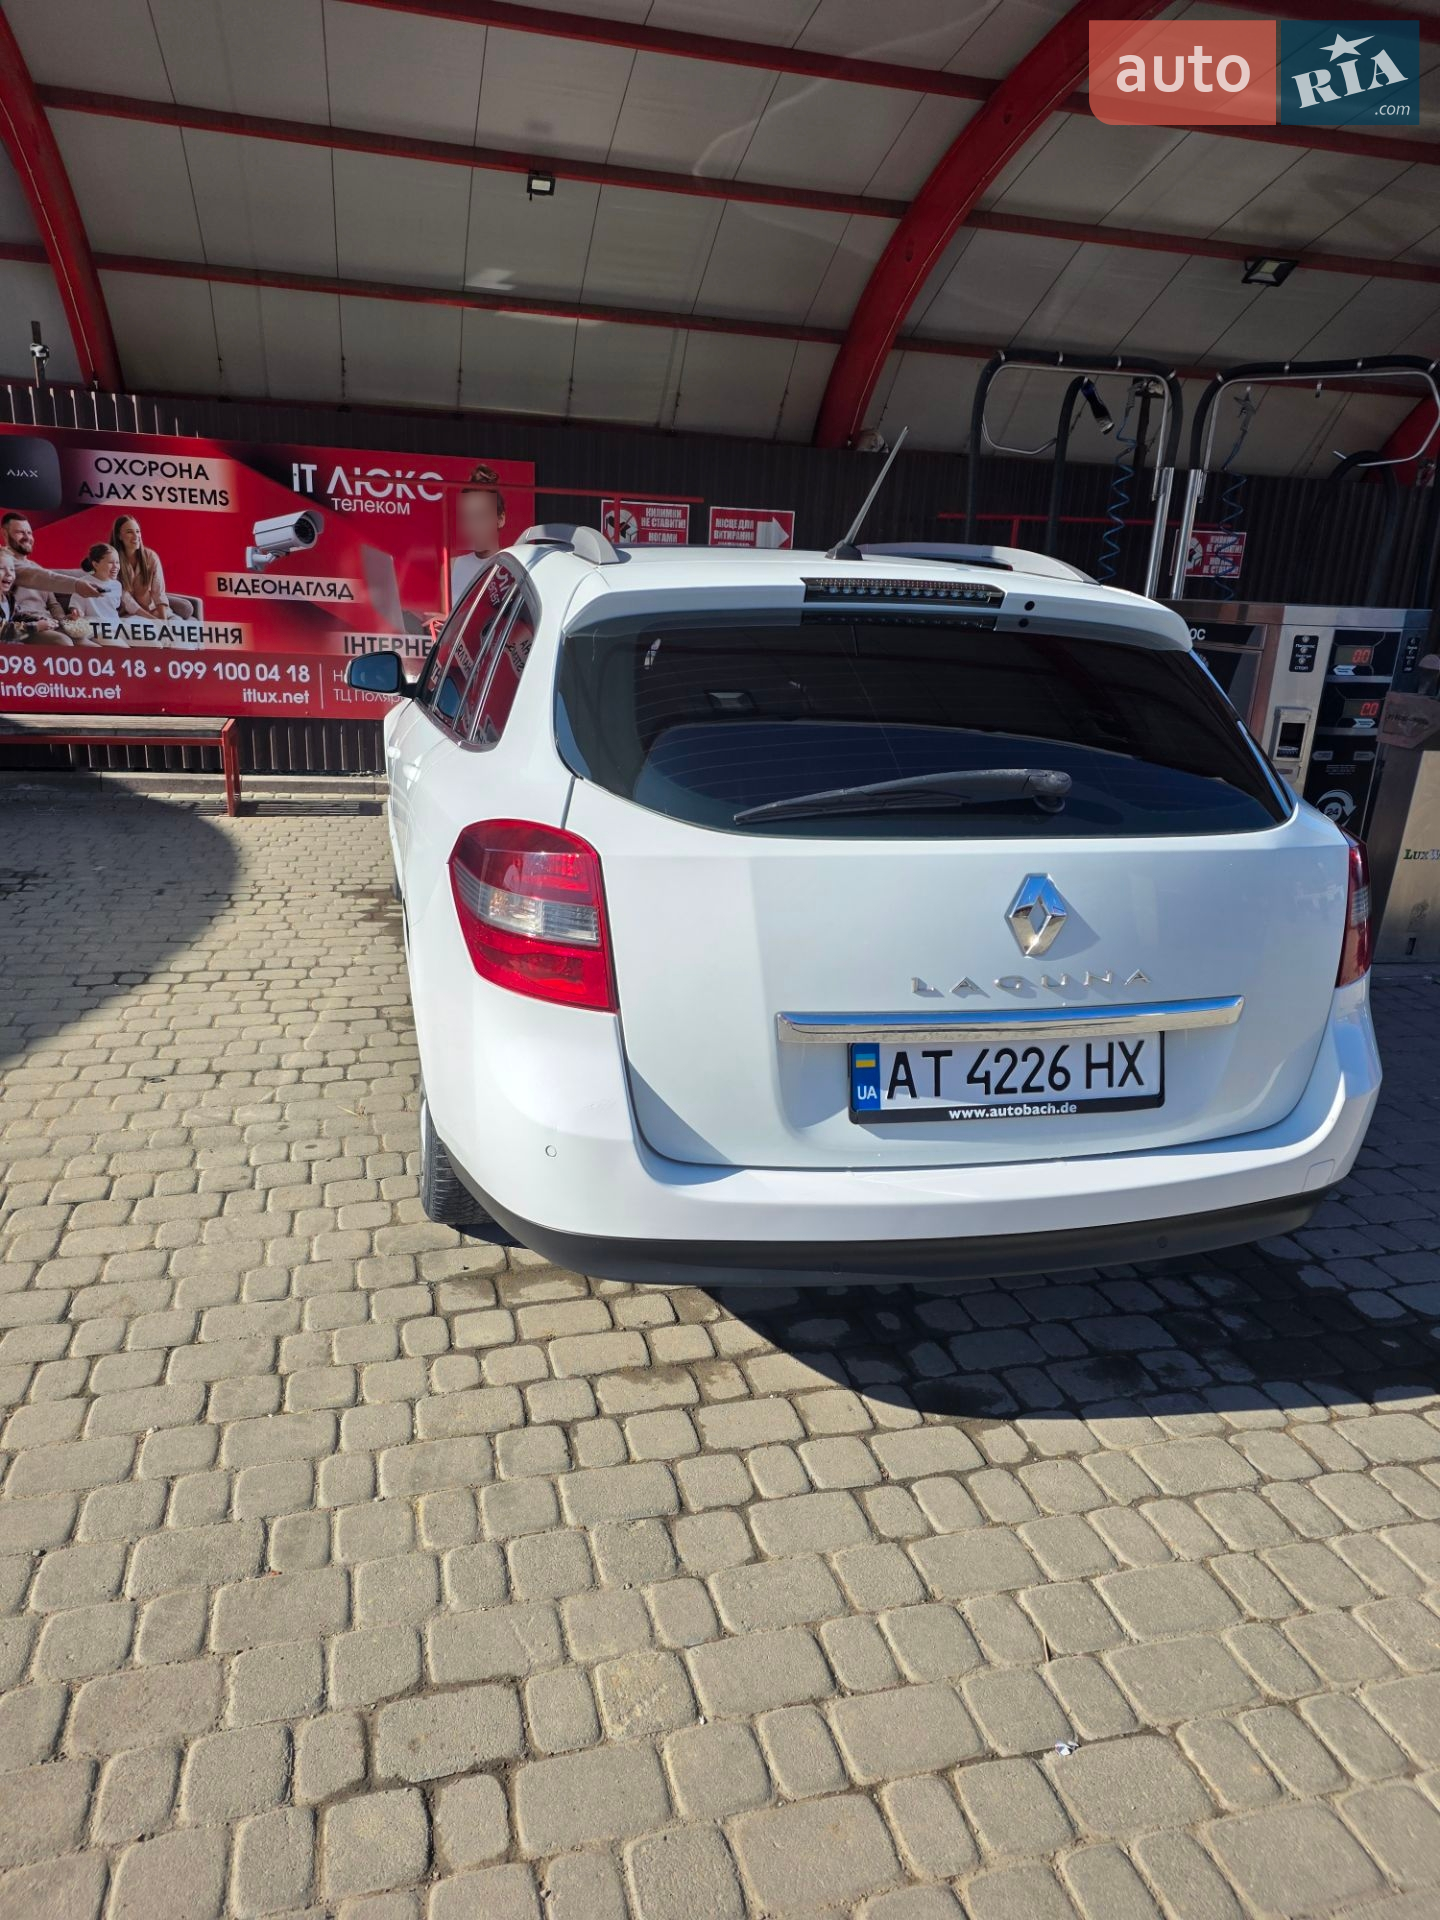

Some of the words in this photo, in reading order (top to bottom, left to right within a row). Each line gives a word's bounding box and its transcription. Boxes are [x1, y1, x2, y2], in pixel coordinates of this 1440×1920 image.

[6, 469, 39, 478] AJAX
[94, 457, 210, 481] ОХОРОНА
[78, 481, 137, 501] AJAX
[142, 485, 230, 507] SYSTEMS
[326, 466, 445, 501] ЛЮКС
[331, 497, 411, 515] телеком
[216, 577, 355, 600] ВІДЕОНАГЛЯД
[90, 622, 243, 644] ТЕЛЕБАЧЕННЯ
[343, 635, 432, 657] ІНТЕРНЕ
[0, 655, 37, 675] 098
[43, 657, 83, 676] 100
[88, 658, 116, 677] 04
[121, 659, 147, 678] 18
[167, 661, 207, 679] 099
[213, 663, 251, 681] 100
[255, 664, 281, 681] 04
[286, 665, 311, 682] 18
[0, 681, 122, 699] info@itlux.net
[242, 688, 310, 704] itlux.net
[333, 688, 352, 703] ТЦ
[1326, 807, 1339, 816] 24
[910, 968, 1152, 995] LAGUNA
[886, 1050, 953, 1100] AT
[966, 1044, 1071, 1096] 4226
[1085, 1039, 1145, 1089] HX
[857, 1085, 878, 1101] UA
[948, 1102, 1077, 1120] www.autobach.de
